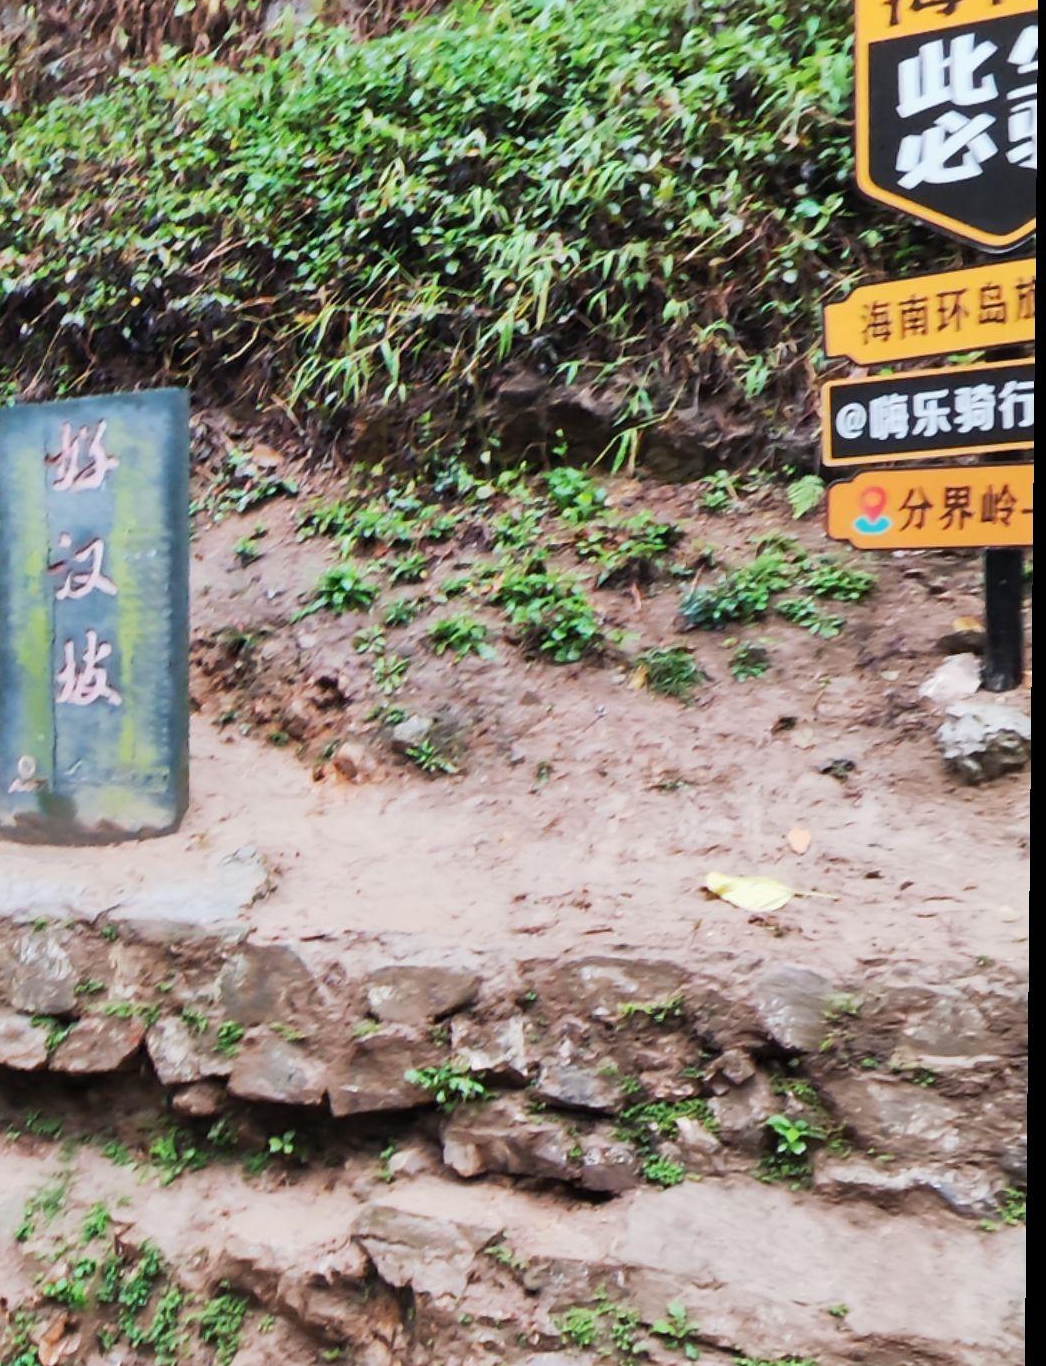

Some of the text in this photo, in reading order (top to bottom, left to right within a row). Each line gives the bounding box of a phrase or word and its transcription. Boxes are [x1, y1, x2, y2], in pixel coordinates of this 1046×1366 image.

[835, 380, 1035, 441] @嗨乐骑行
[45, 417, 123, 707] 好汉坡
